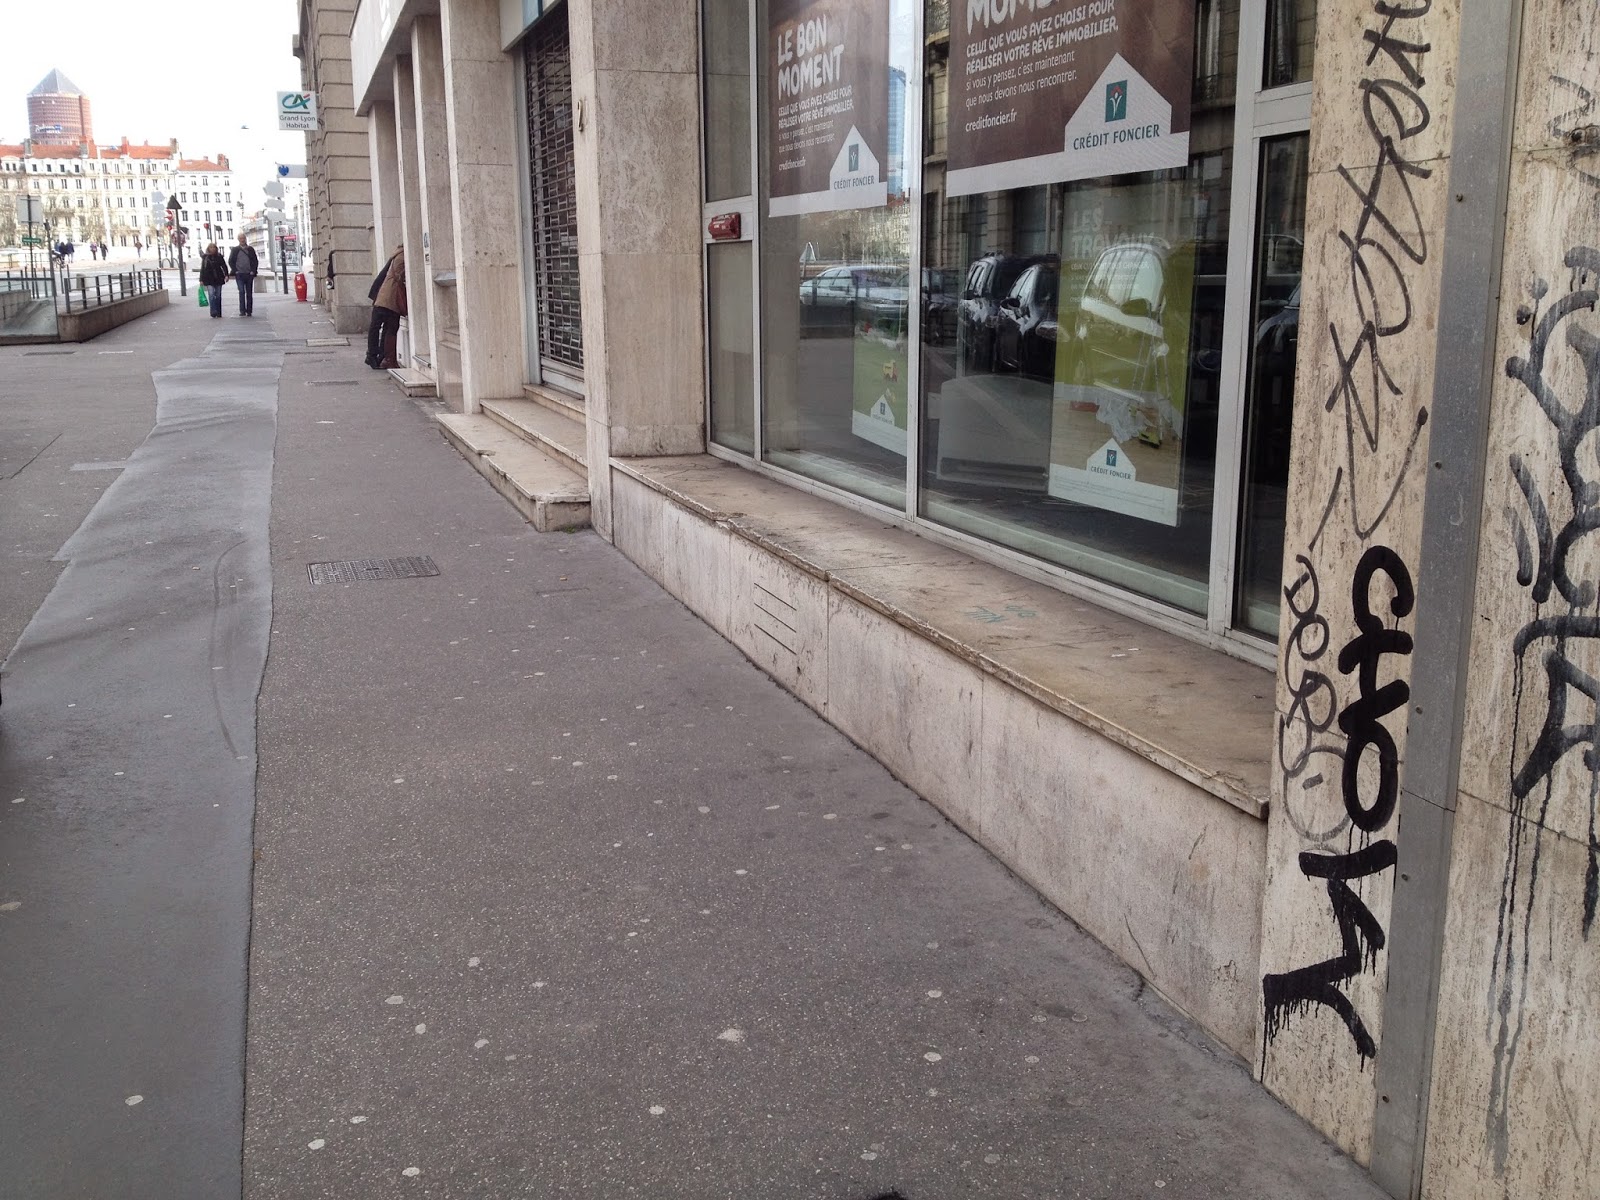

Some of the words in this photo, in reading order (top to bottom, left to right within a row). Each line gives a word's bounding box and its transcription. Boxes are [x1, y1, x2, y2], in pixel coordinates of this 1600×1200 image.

[777, 29, 793, 67] LE
[796, 13, 827, 58] BON
[966, 39, 987, 58] CELUI
[988, 33, 1004, 52] QUE
[1005, 25, 1028, 45] VOUS
[1029, 16, 1053, 37] AVEZ
[1054, 5, 1087, 29] CHOISI
[1088, 0, 1115, 18] POUR
[777, 43, 845, 101] MOMENT
[965, 79, 972, 91] si
[972, 76, 987, 89] vous
[987, 75, 992, 88] y
[992, 67, 1017, 87] pensez,
[1017, 61, 1033, 76] c'est
[1034, 51, 1075, 72] maintenant
[966, 51, 1002, 76] RÉALISER
[1003, 42, 1031, 63] VOTRE
[1031, 35, 1054, 56] RÊVE
[839, 84, 852, 99] POUR
[965, 96, 978, 111] que
[978, 92, 993, 104] nous
[994, 85, 1017, 101] devons
[1018, 80, 1035, 95] nous
[1036, 69, 1077, 90] rencontrer.
[965, 108, 1017, 132] creditfoncier.fr
[1073, 132, 1110, 151] CRÉDIT
[1113, 124, 1160, 144] FONCIER
[833, 177, 852, 190] CRÉDIT
[852, 175, 875, 187] FONCIER
[1090, 465, 1108, 476] CRÉDIT
[1109, 470, 1132, 480] FONCIER
